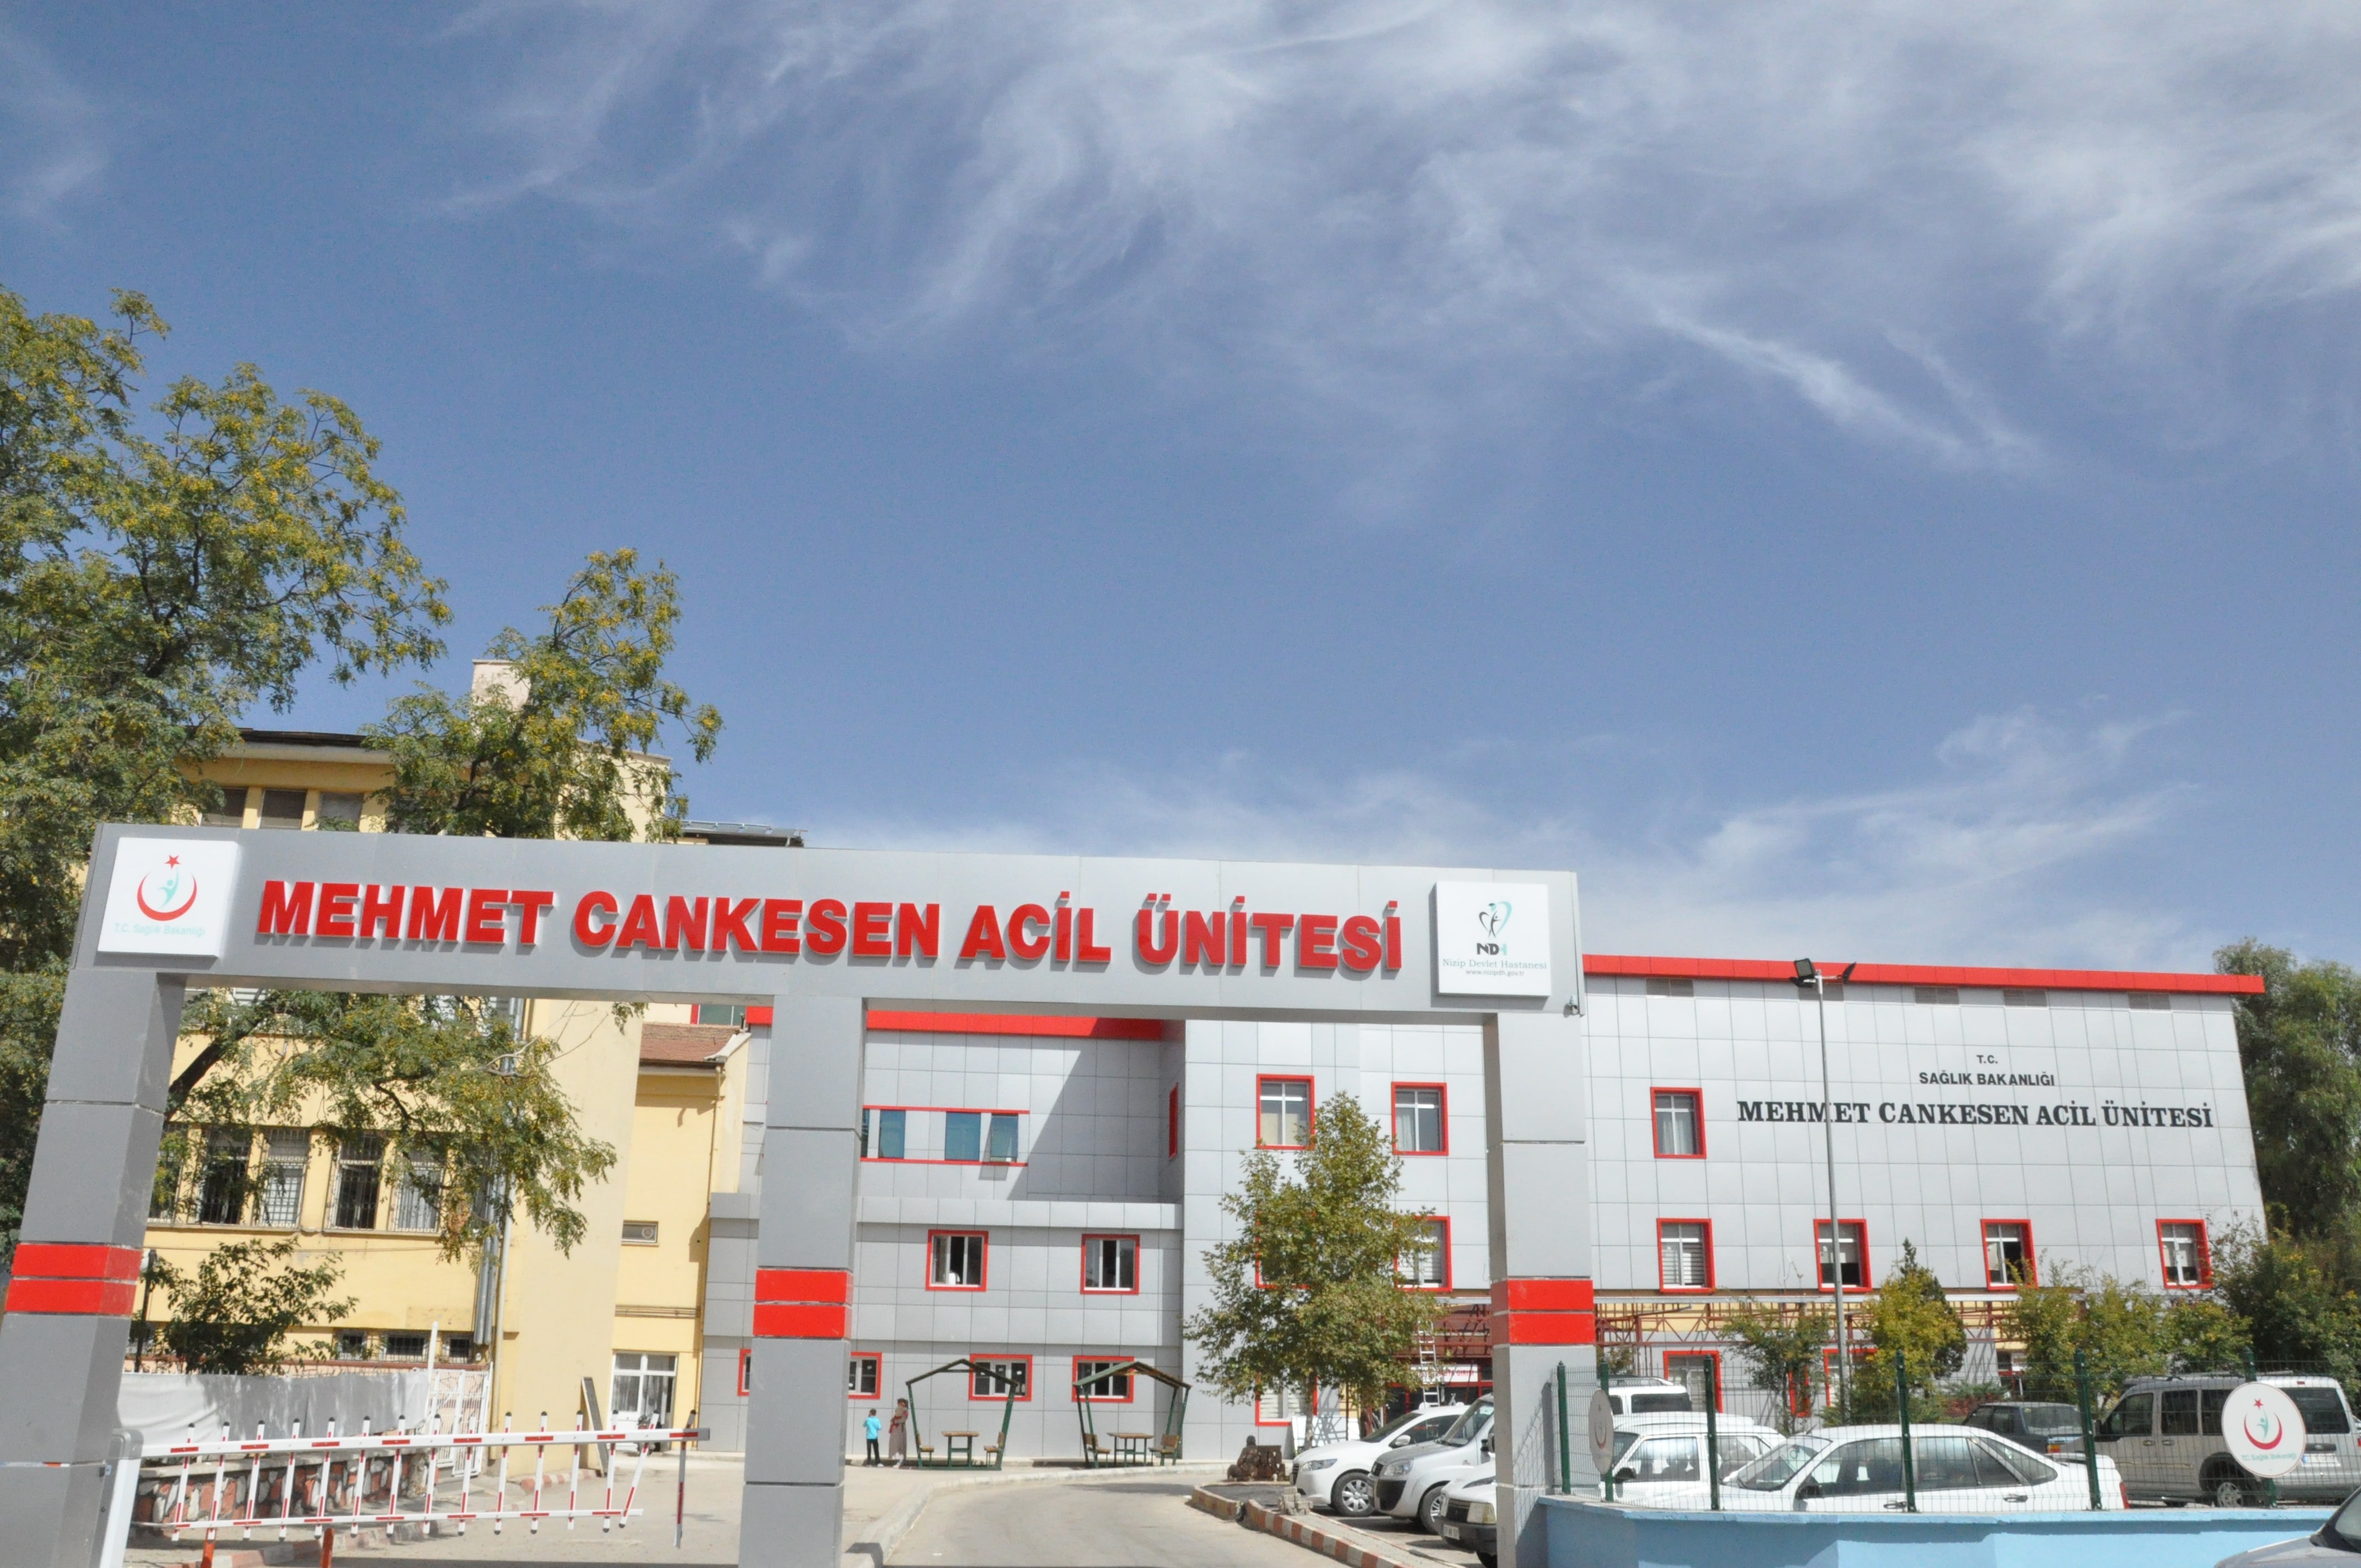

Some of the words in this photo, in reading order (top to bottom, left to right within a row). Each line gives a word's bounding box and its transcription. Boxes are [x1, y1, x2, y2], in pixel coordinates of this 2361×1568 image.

[257, 880, 556, 945] MEHMET
[574, 890, 940, 959] CANKESEN
[960, 890, 1112, 962] ACİL
[1138, 892, 1402, 971] ÜNİTESİ
[1443, 958, 1466, 968] Nizip
[1469, 959, 1498, 968] Devlet
[1501, 960, 1547, 970] Hastanesi
[1977, 1054, 1998, 1064] T.C.
[1919, 1070, 1973, 1085] SAĞLIK
[1977, 1071, 2055, 1086] BAKANLIĞI
[1737, 1101, 1870, 1123] MEHMET
[1878, 1102, 2028, 1125] CANKESEN
[2036, 1100, 2096, 1126] ACİL
[2101, 1099, 2214, 1128] ÜNİTESİ
